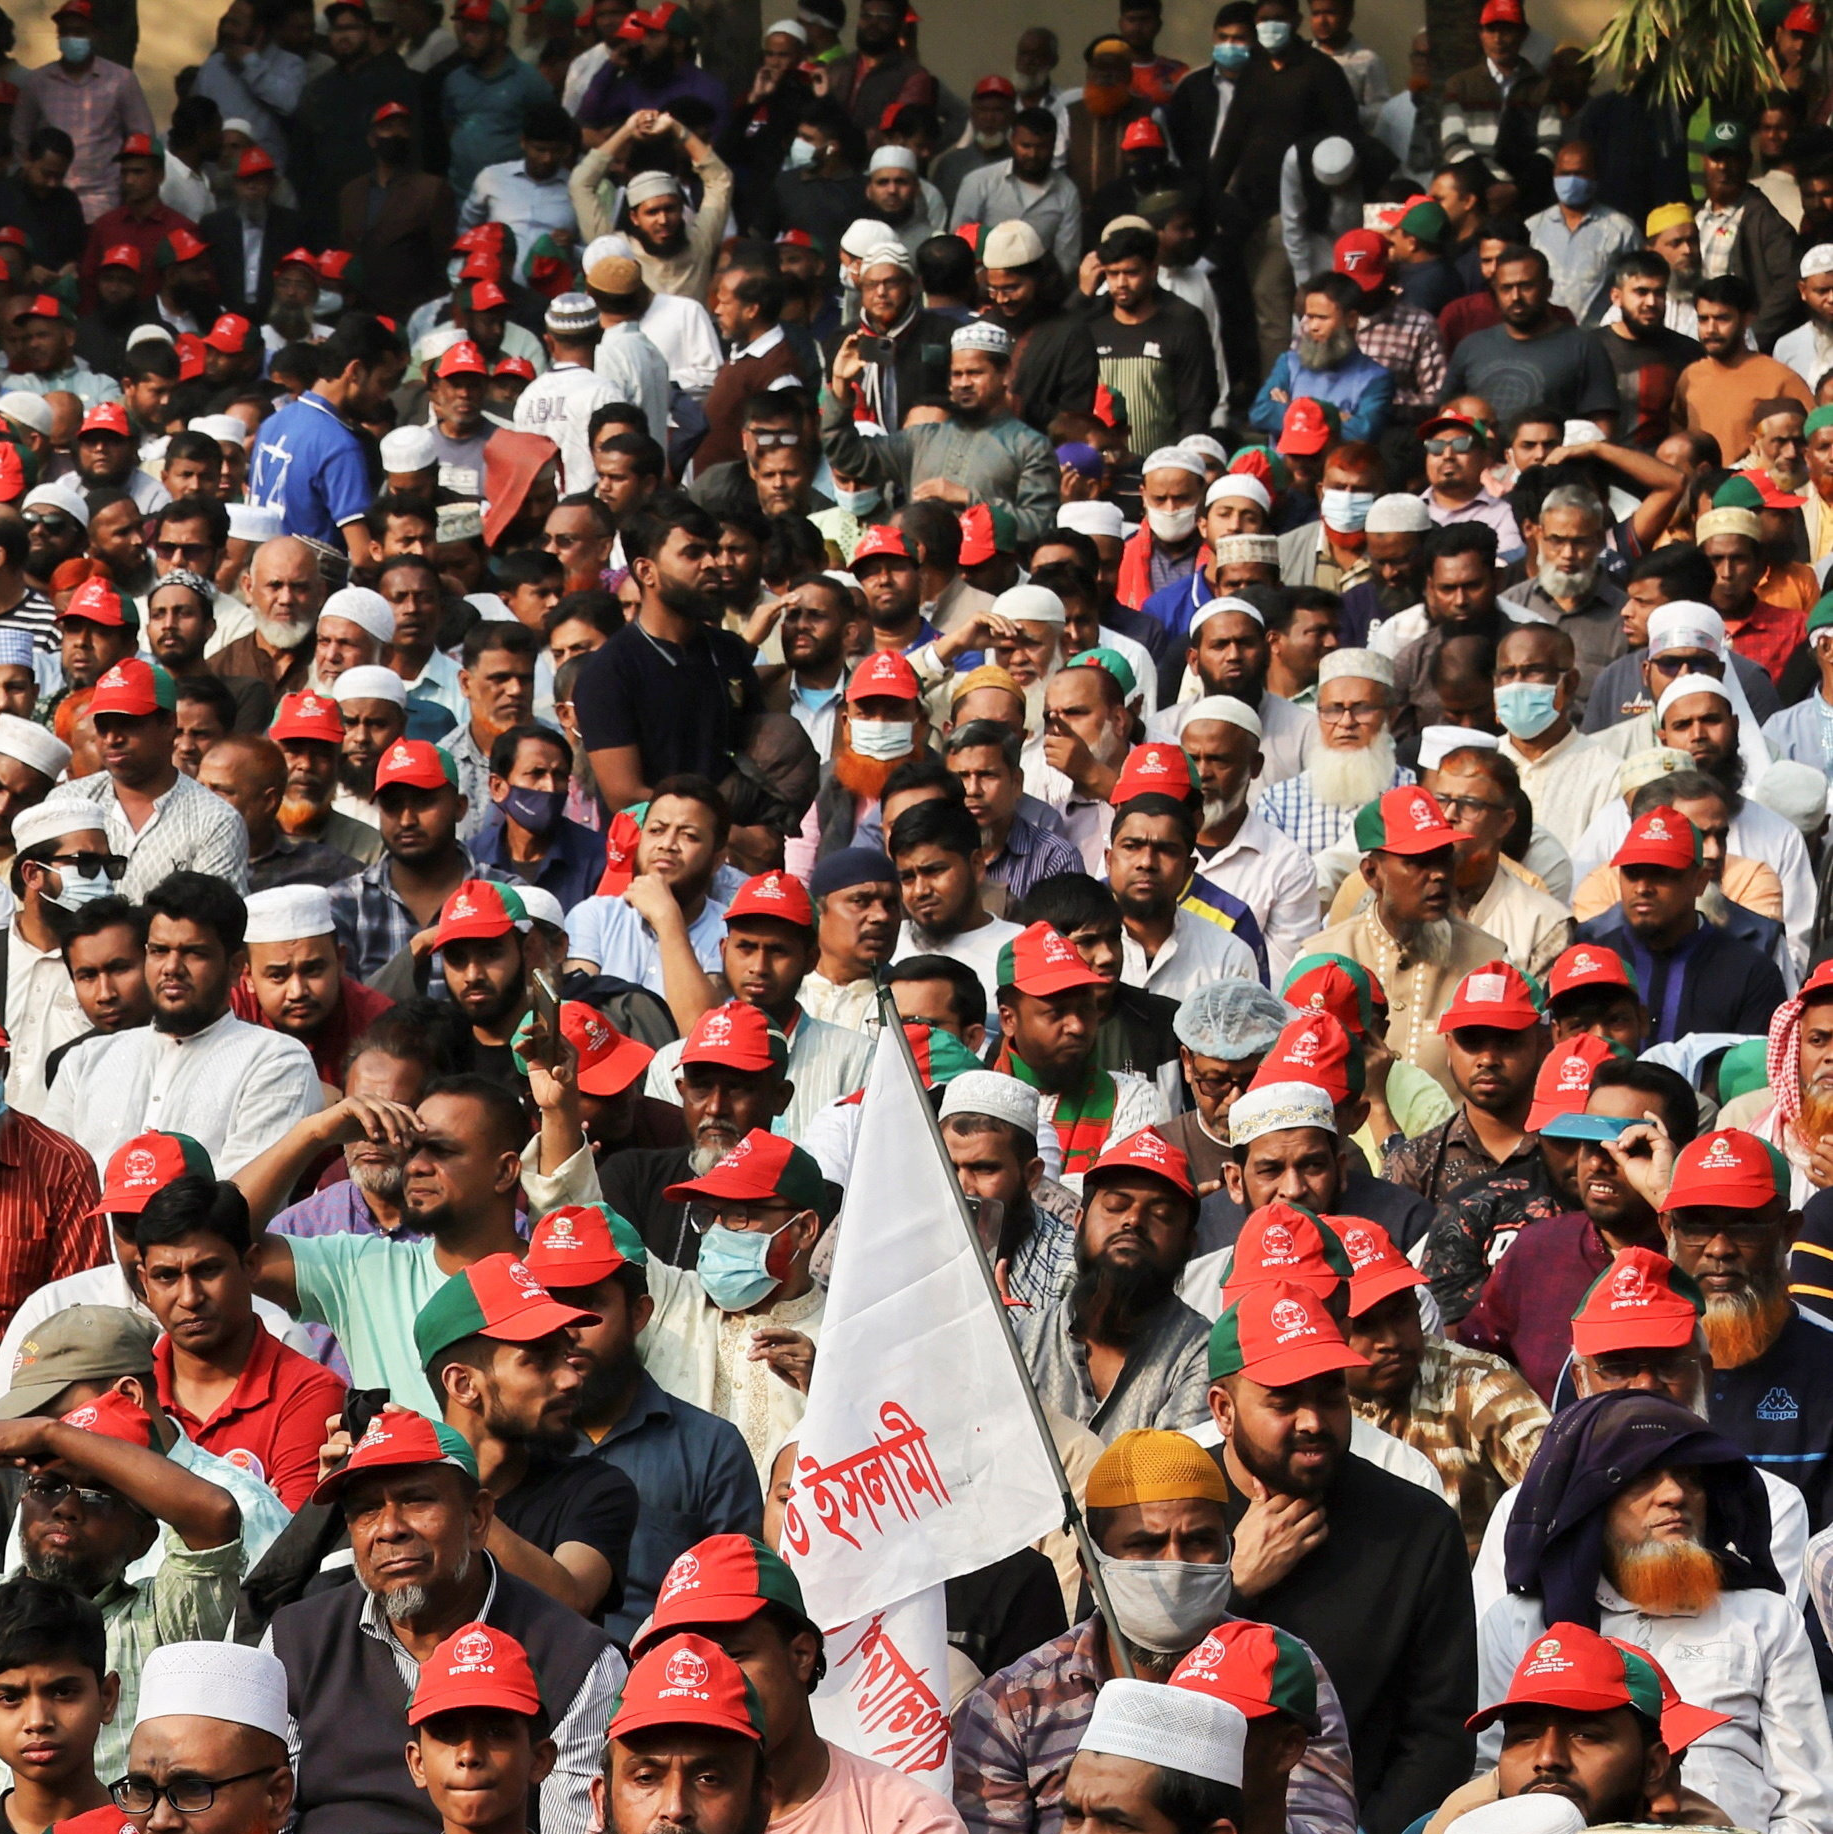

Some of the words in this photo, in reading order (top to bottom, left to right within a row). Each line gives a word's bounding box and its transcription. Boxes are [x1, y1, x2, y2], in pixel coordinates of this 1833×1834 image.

[124, 1176, 157, 1188] ঢাকা-১৫
[1261, 1255, 1300, 1267] ঢাকা-১৫
[1610, 1298, 1648, 1311] ঢাকা-১৫
[1276, 1327, 1317, 1343] ঢাকা-১৫
[1757, 1410, 1798, 1422] Kappa
[799, 1401, 952, 1551] ইসলামী
[448, 1663, 495, 1676] ঢাকা-১৫
[657, 1687, 710, 1701] ঢাকা-১৫
